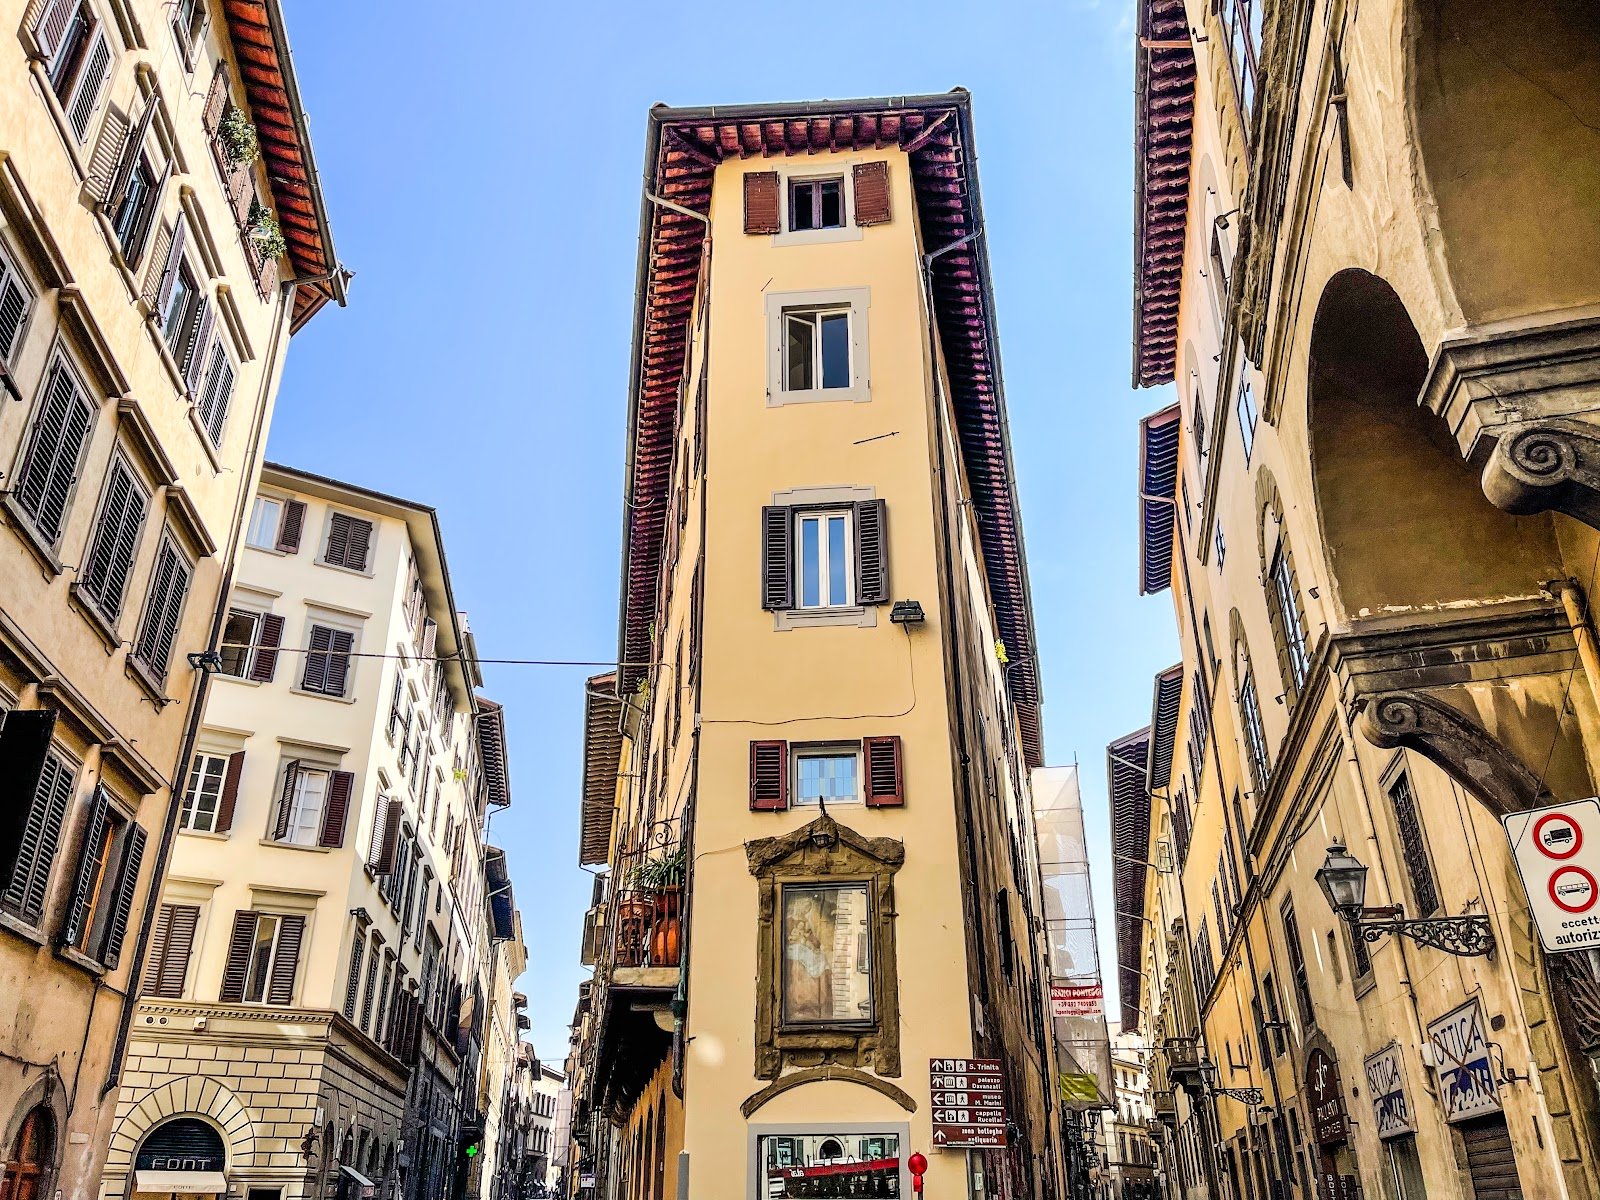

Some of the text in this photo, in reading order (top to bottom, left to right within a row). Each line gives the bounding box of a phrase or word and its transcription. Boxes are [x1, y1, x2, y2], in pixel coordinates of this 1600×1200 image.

[1561, 916, 1600, 928] eccett
[1555, 929, 1600, 944] autoriz
[1072, 988, 1102, 997] PONTEGGI
[1433, 1014, 1485, 1066] OTTICA
[1367, 1055, 1400, 1093] OTTICA
